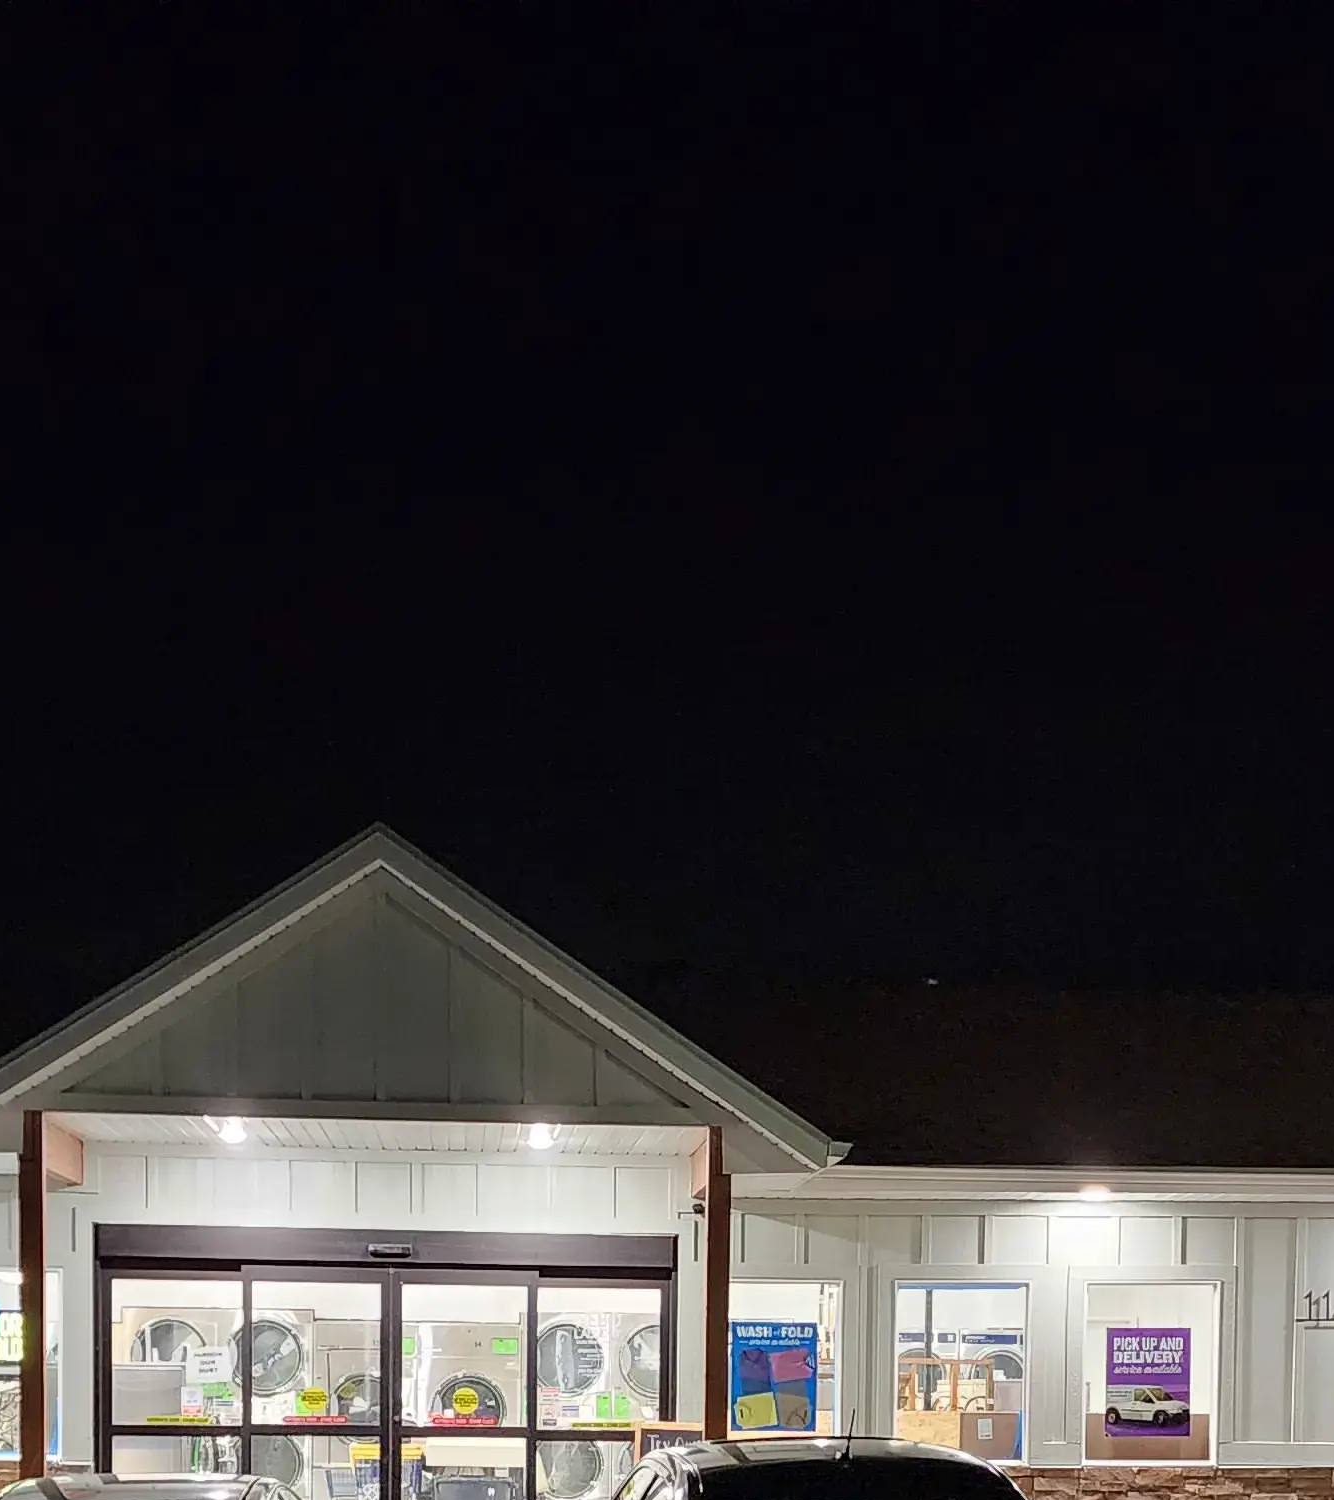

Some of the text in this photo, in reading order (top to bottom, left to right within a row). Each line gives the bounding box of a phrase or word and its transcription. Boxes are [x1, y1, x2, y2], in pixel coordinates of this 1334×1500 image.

[736, 1325, 773, 1338] WASH
[781, 1327, 813, 1338] FOLD
[1113, 1337, 1184, 1351] PICK UP AND
[1113, 1351, 1183, 1364] DELIVERY
[1113, 1364, 1182, 1375] service available
